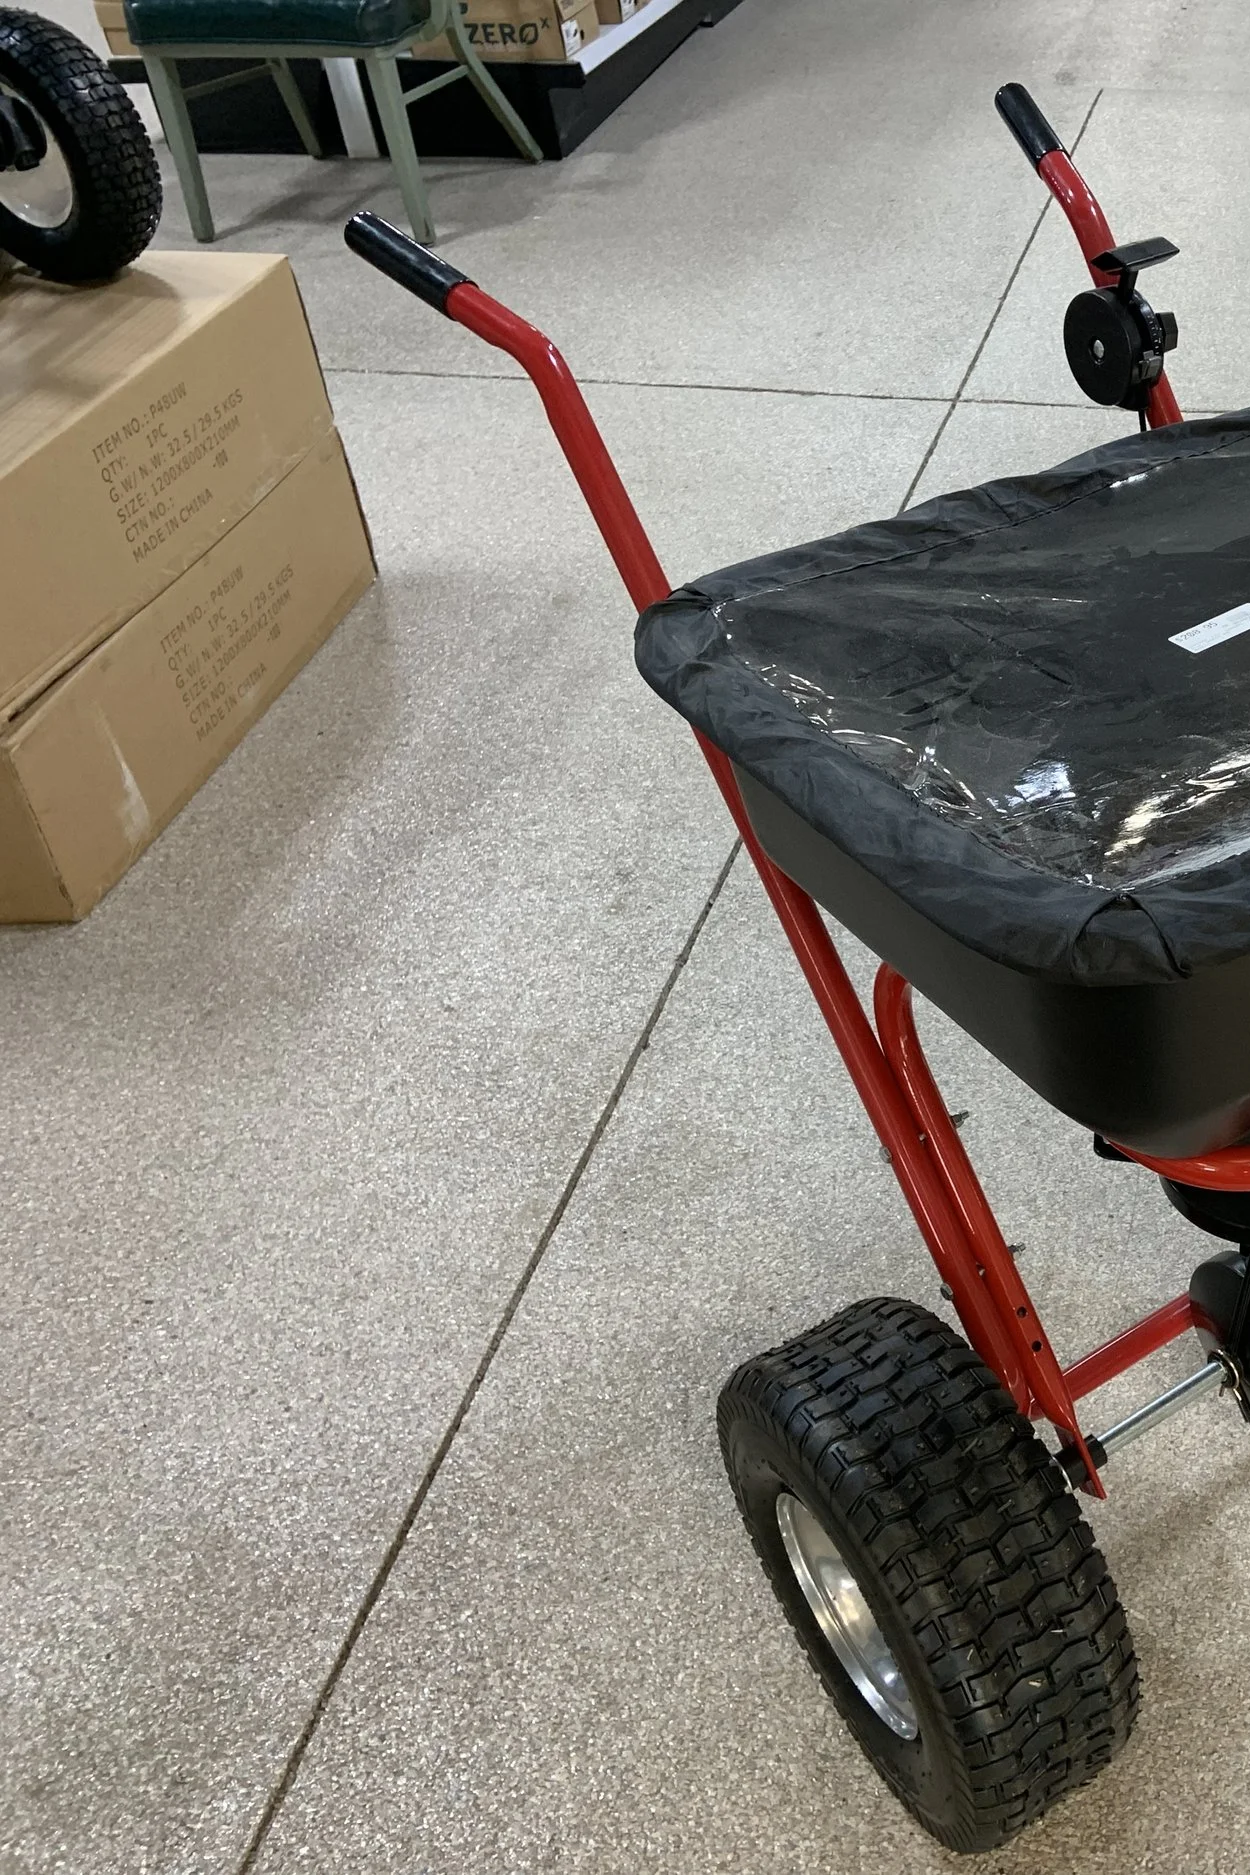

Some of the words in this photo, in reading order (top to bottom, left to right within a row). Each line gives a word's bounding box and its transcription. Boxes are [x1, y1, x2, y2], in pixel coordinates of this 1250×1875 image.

[91, 431, 123, 464] ITEM
[101, 456, 129, 483] QTY:
[146, 422, 168, 448] 1PC
[166, 429, 192, 457] 32.5
[116, 492, 150, 525] SIZE:
[125, 518, 149, 543] CTN
[132, 527, 166, 564] MADE
[165, 516, 180, 536] IN
[179, 488, 214, 523] CHINA
[160, 620, 187, 655] ITEM
[168, 642, 191, 672] QTY:
[207, 606, 228, 632] 1PC
[226, 609, 249, 638] 32.5
[181, 674, 212, 709] SIZE:
[195, 706, 226, 742] MADE
[225, 695, 238, 713] IN
[236, 662, 268, 697] CHINA
[189, 701, 212, 725] CTN
